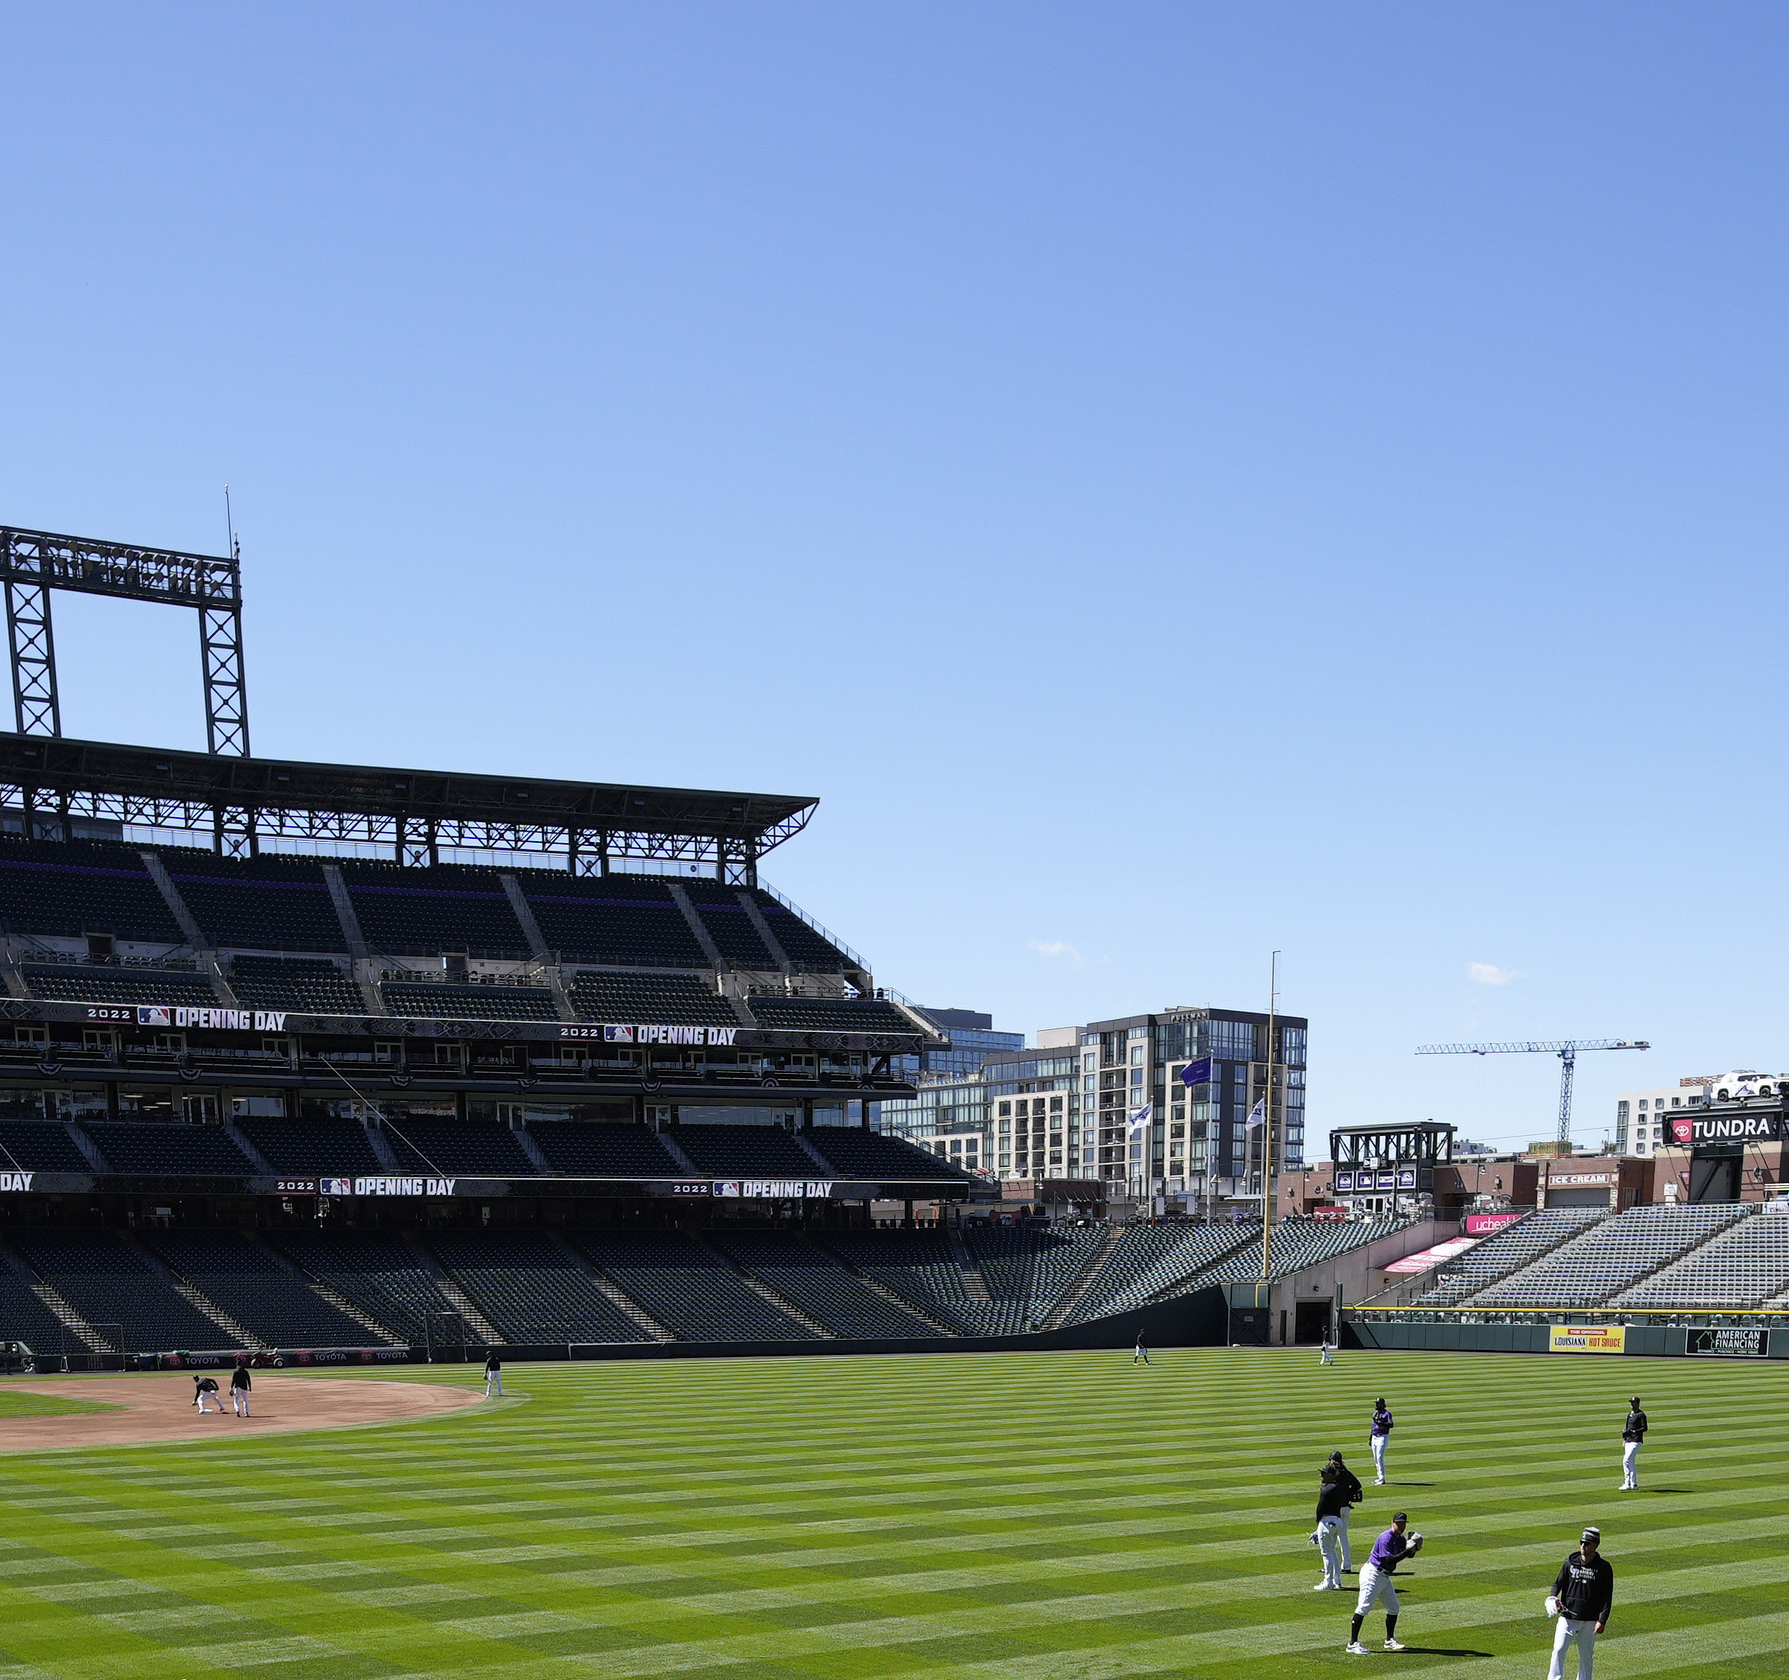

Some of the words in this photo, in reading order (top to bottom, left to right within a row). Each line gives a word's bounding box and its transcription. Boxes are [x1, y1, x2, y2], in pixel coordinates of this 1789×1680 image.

[88, 1008, 131, 1019] 2022
[175, 1008, 251, 1030] OPENING
[254, 1013, 287, 1032] DAY
[560, 1028, 598, 1037] 2022
[637, 1026, 704, 1045] OPENING
[707, 1029, 737, 1046] DAY
[1692, 1117, 1770, 1139] TUNDRA
[0, 1173, 33, 1191] DAY
[1552, 1176, 1568, 1184] ICE
[1570, 1174, 1606, 1184] CREAM
[277, 1181, 314, 1190] 2022
[355, 1178, 423, 1196] OPENING
[426, 1179, 456, 1196] DAY
[674, 1185, 708, 1193] 2022
[742, 1181, 804, 1198] OPENING
[806, 1182, 833, 1198] DAY
[1716, 1330, 1761, 1340] AMERICAN
[1554, 1336, 1586, 1346] LOUISIANA
[1589, 1337, 1600, 1347] HOT
[1602, 1338, 1621, 1348] SAUCE
[1715, 1339, 1760, 1349] FINANCING
[185, 1356, 220, 1367] TOYOTA
[314, 1352, 348, 1363] TOYOTA
[375, 1351, 409, 1361] TOYOTA
